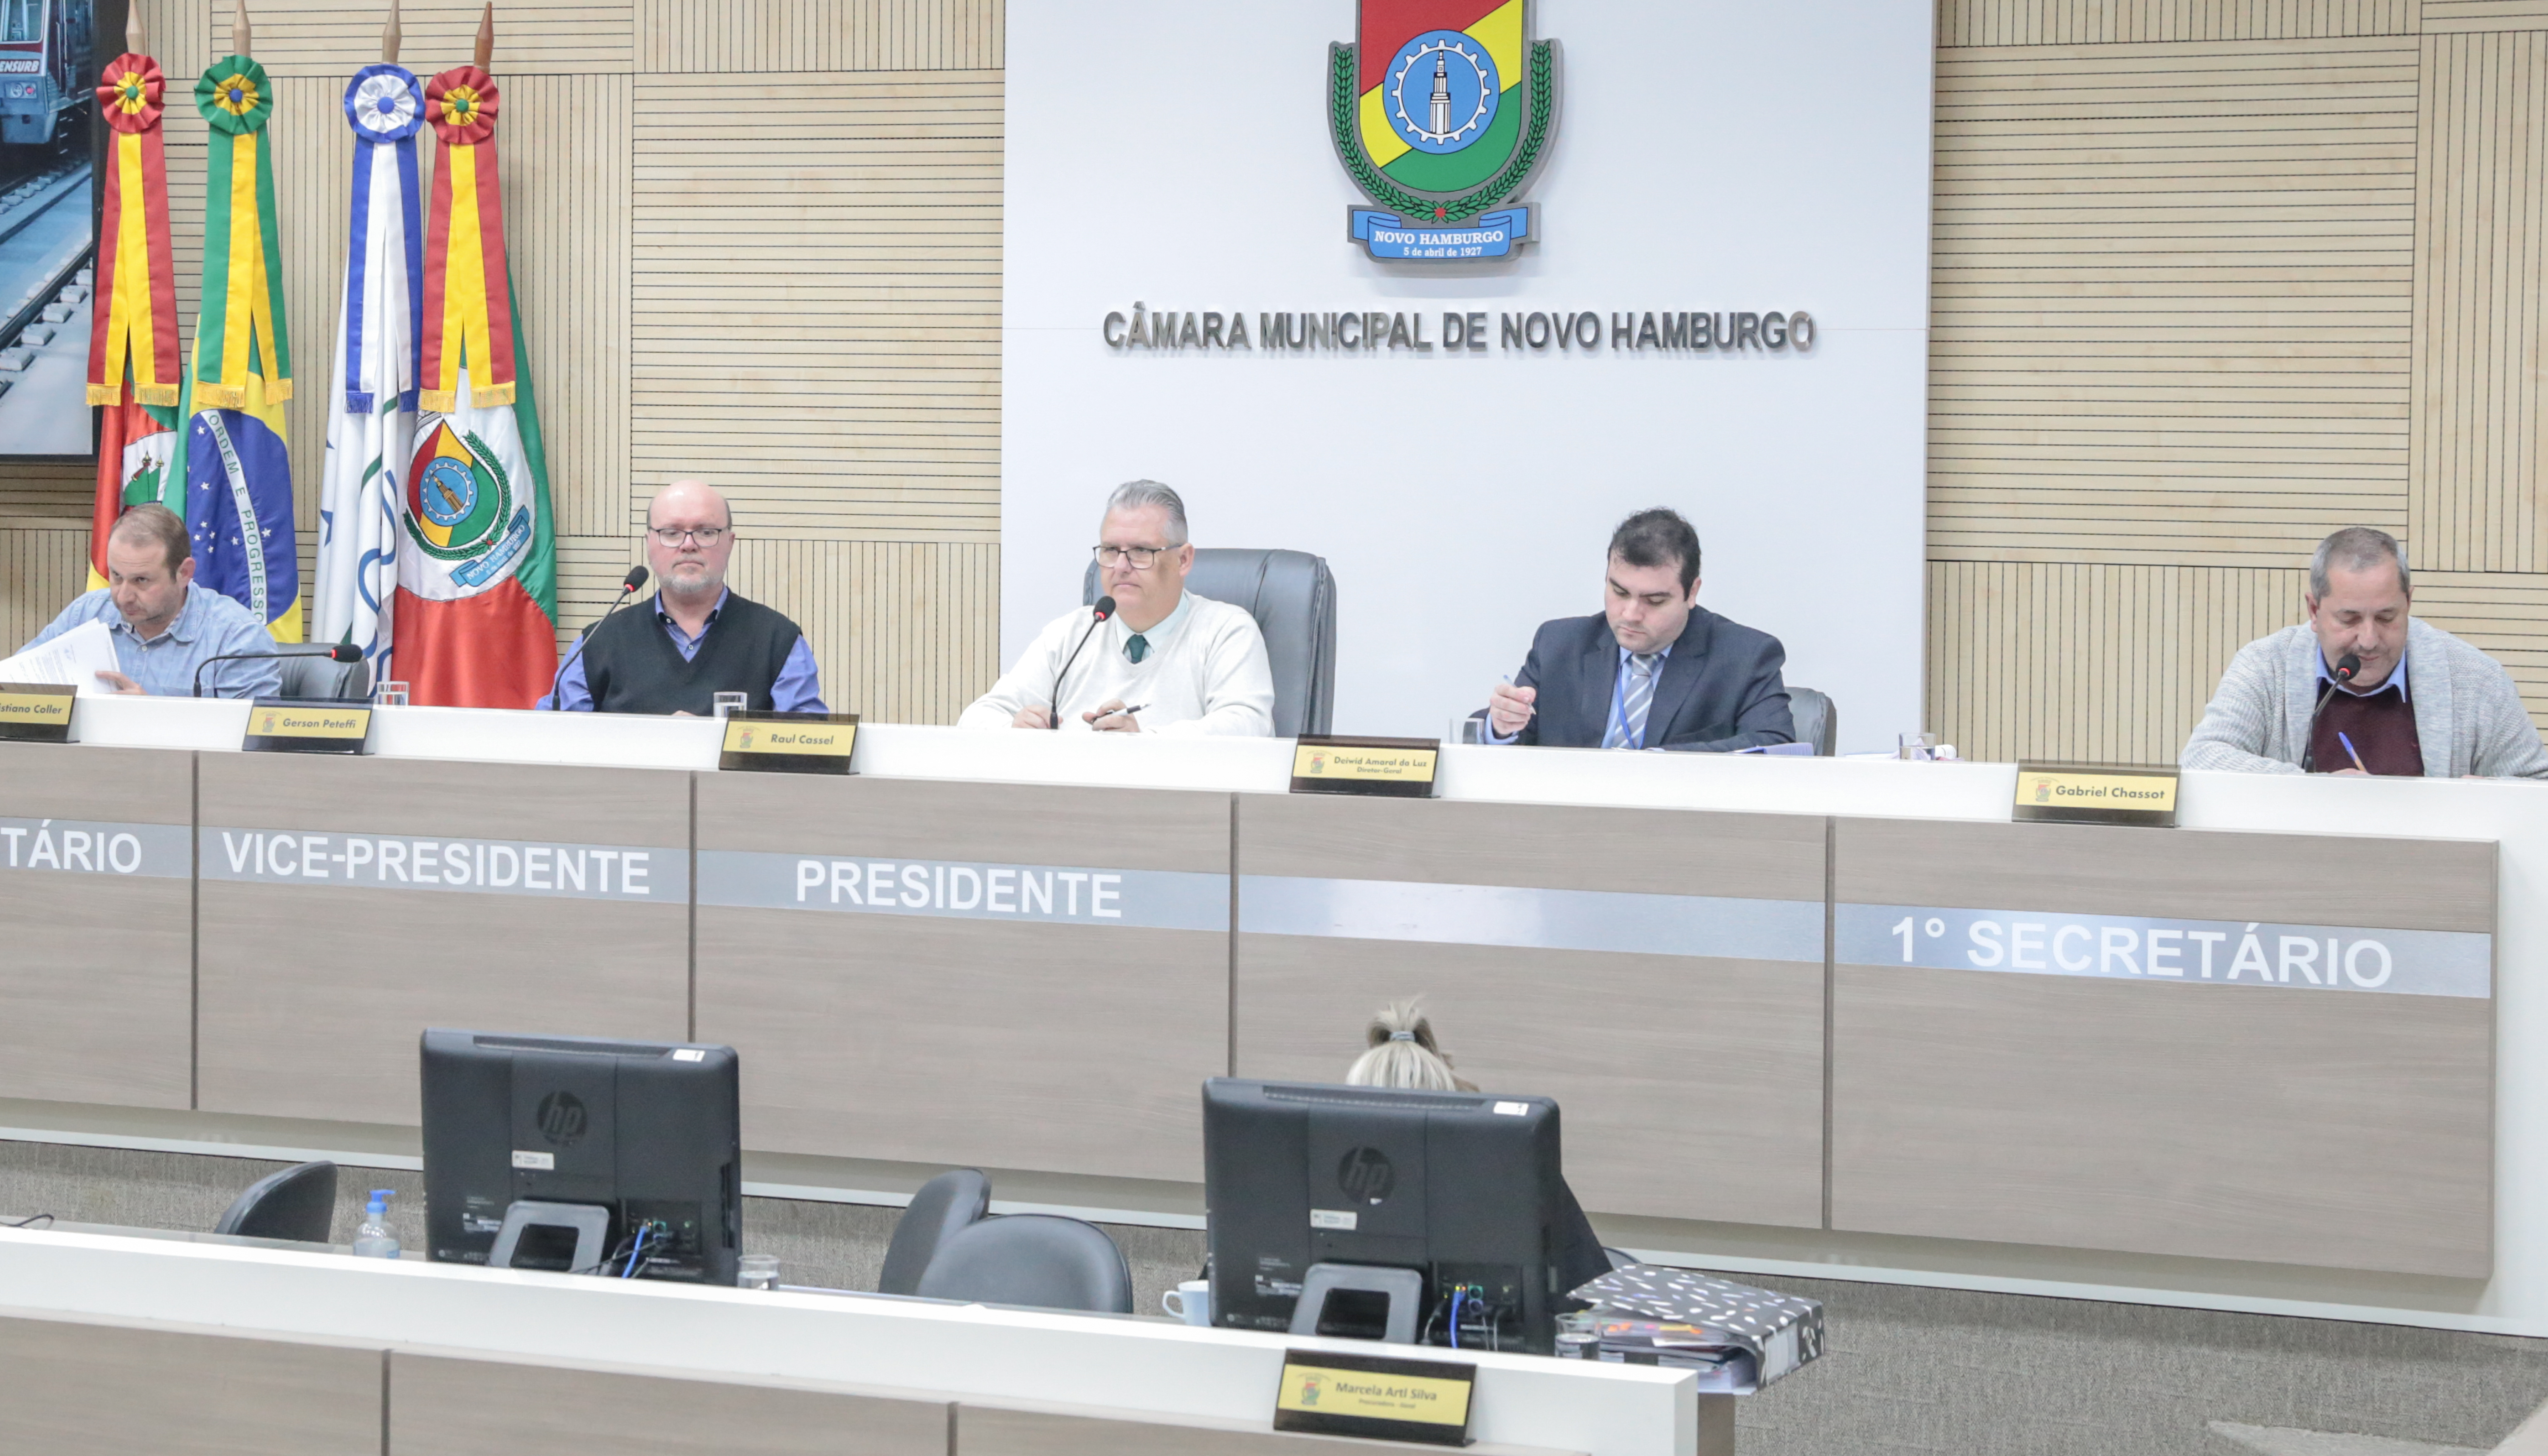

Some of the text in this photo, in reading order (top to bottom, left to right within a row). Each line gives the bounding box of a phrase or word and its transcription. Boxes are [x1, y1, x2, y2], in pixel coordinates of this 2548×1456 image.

[1374, 231, 1504, 245] NOVO HAMBURGO
[1404, 247, 1482, 256] 5 de abril de 1927
[1104, 301, 1817, 351] CÂMARA MUNICIPAL DE NOVO HAMBURGO
[209, 414, 264, 622] ORDEM E PROGRESSO
[467, 525, 525, 580] NOVO HAMBURGO
[34, 704, 62, 713] Coller
[283, 718, 356, 728] Gerson Peteffi
[771, 734, 834, 744] Raul Cassel
[2056, 786, 2165, 799] Gabriel Chassot
[0, 819, 141, 873] TÁRIO
[223, 832, 649, 894] VICE-PRESIDENTE
[797, 860, 1122, 918] PRESIDENTE
[1967, 923, 2393, 988] SECRETÁRIO
[543, 1091, 582, 1144] hp
[1344, 1147, 1390, 1203] hp
[1336, 1383, 1381, 1396] Marcela
[1411, 1388, 1437, 1400] Silva
